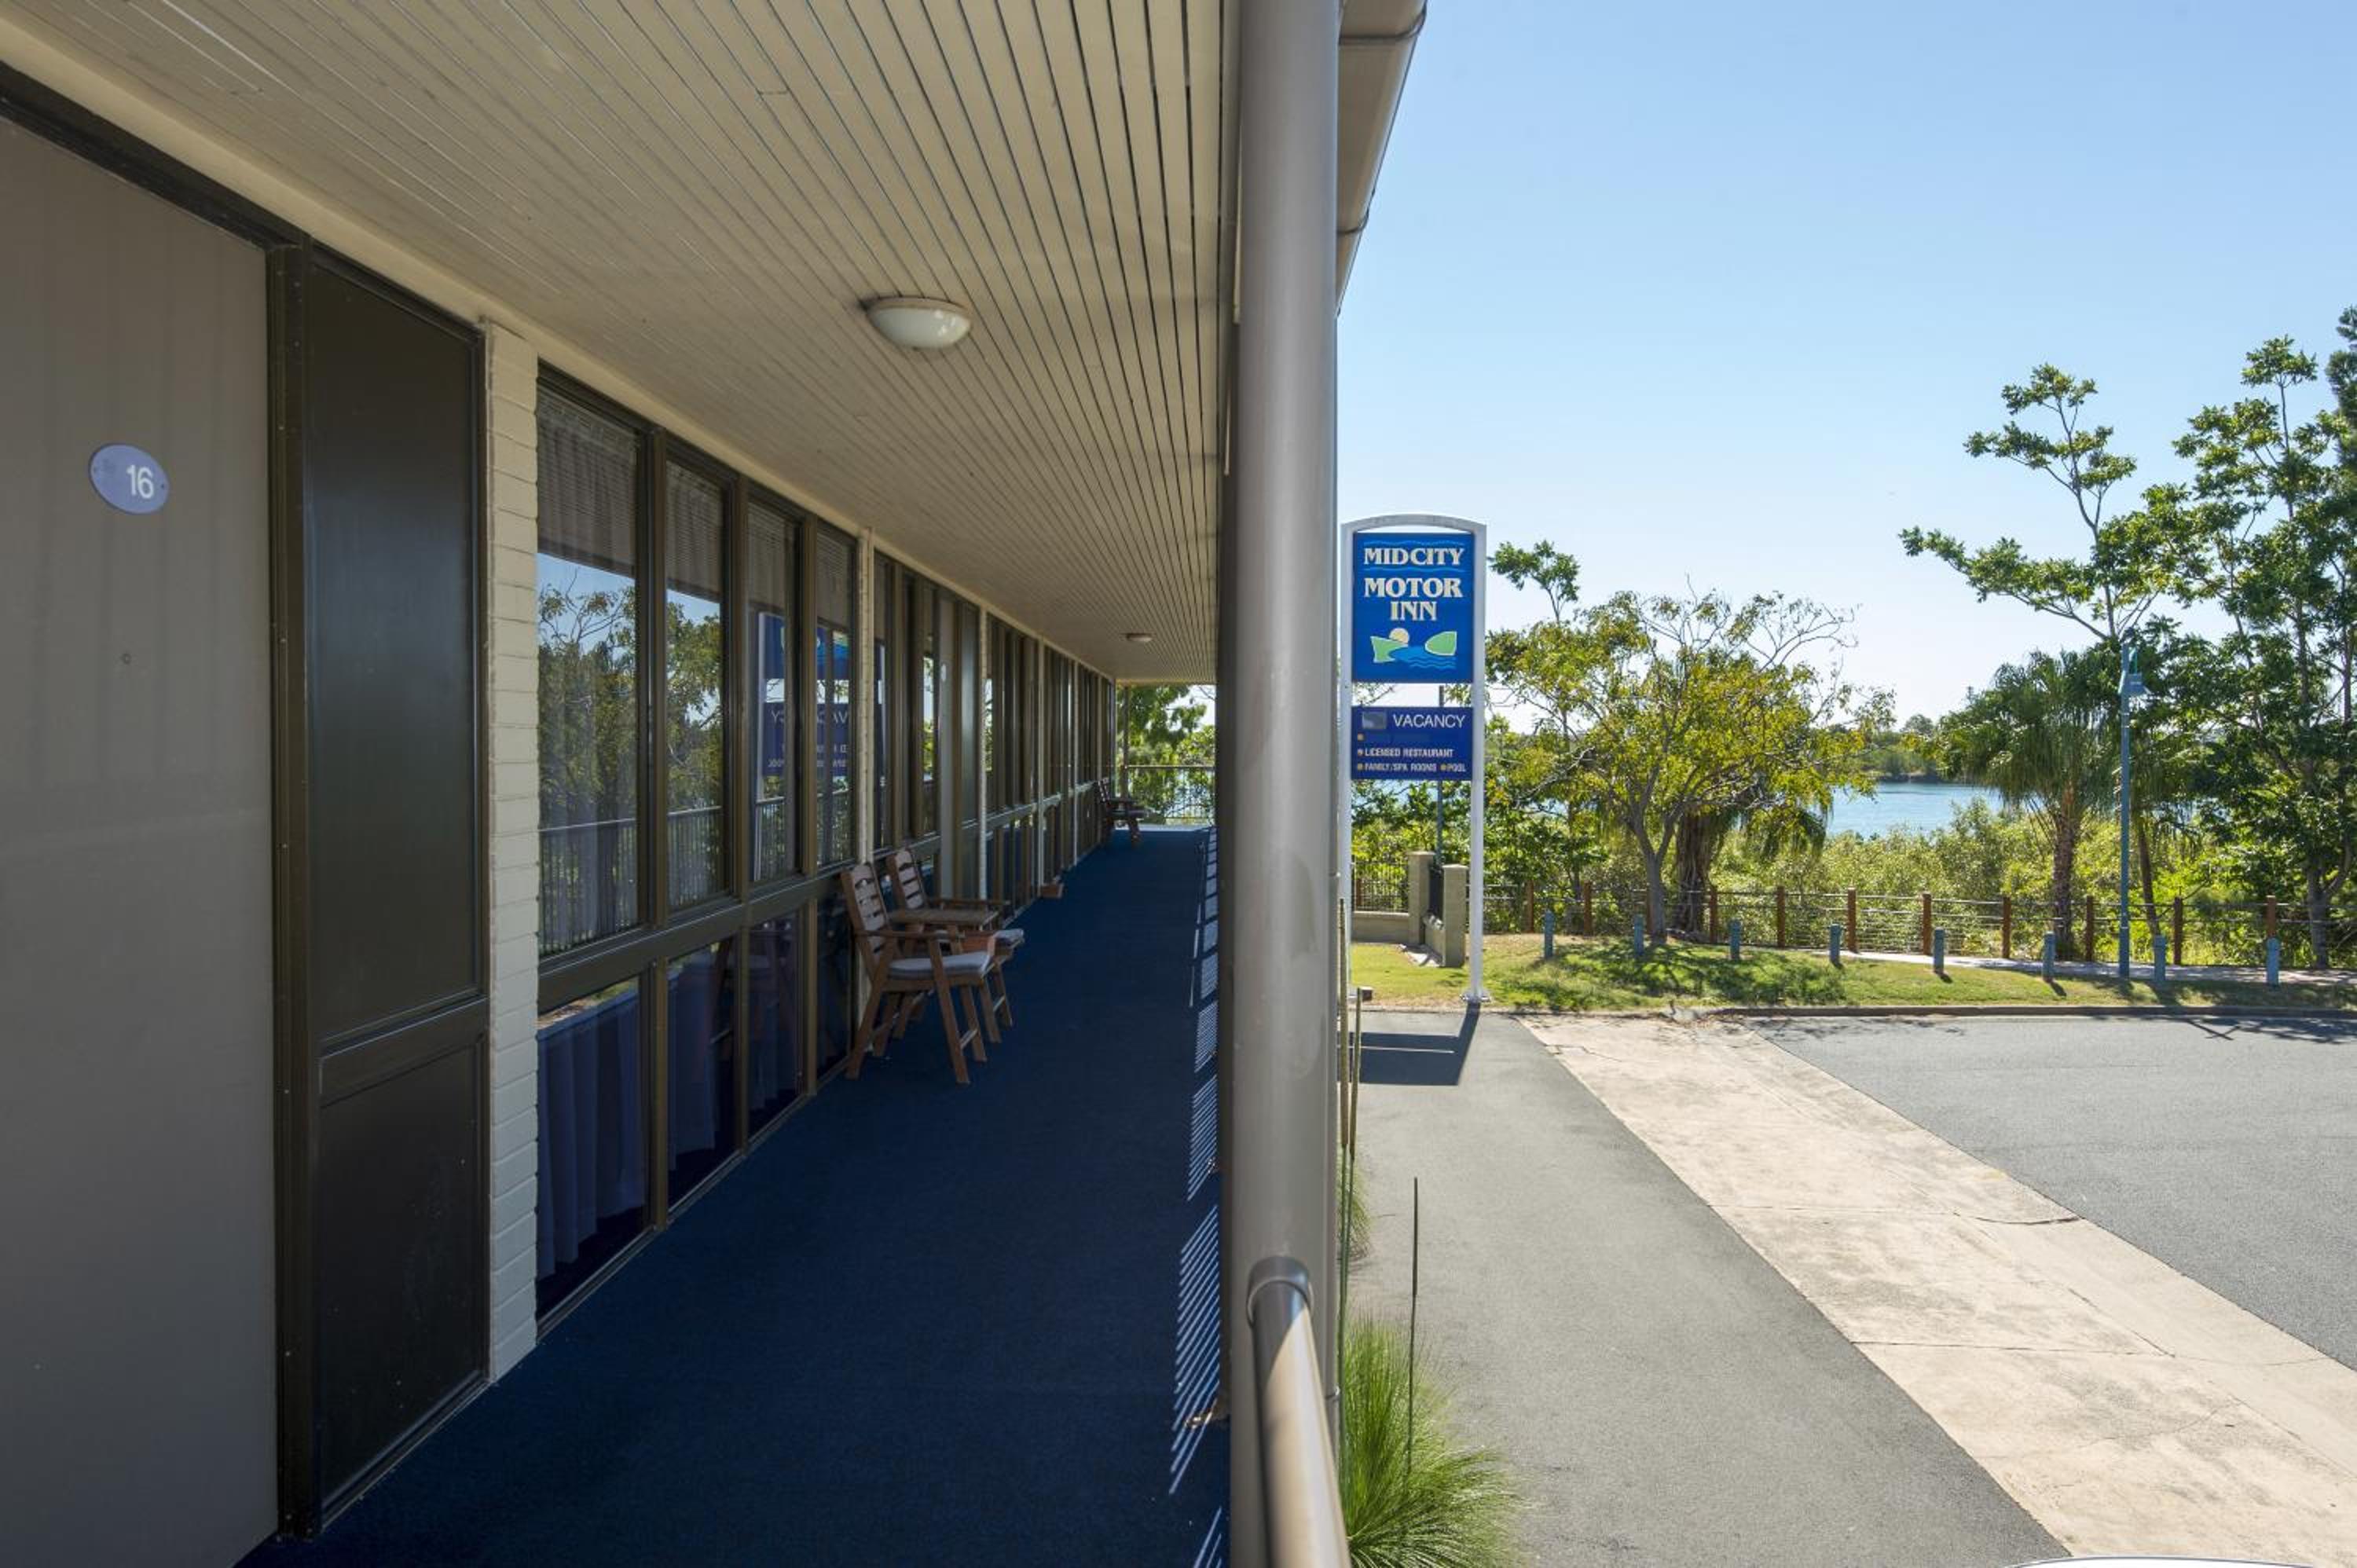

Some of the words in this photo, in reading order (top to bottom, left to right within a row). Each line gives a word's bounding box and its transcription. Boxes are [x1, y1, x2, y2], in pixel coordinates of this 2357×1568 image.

[126, 464, 155, 499] 16
[1363, 548, 1464, 566] MIDCITY
[1364, 577, 1463, 598] MOTOR
[1389, 601, 1438, 621] INN
[1393, 714, 1466, 728] VACANCY
[1365, 748, 1401, 757] LICENSED
[1403, 749, 1454, 757] RESTAURANT
[1446, 764, 1466, 772] POOL
